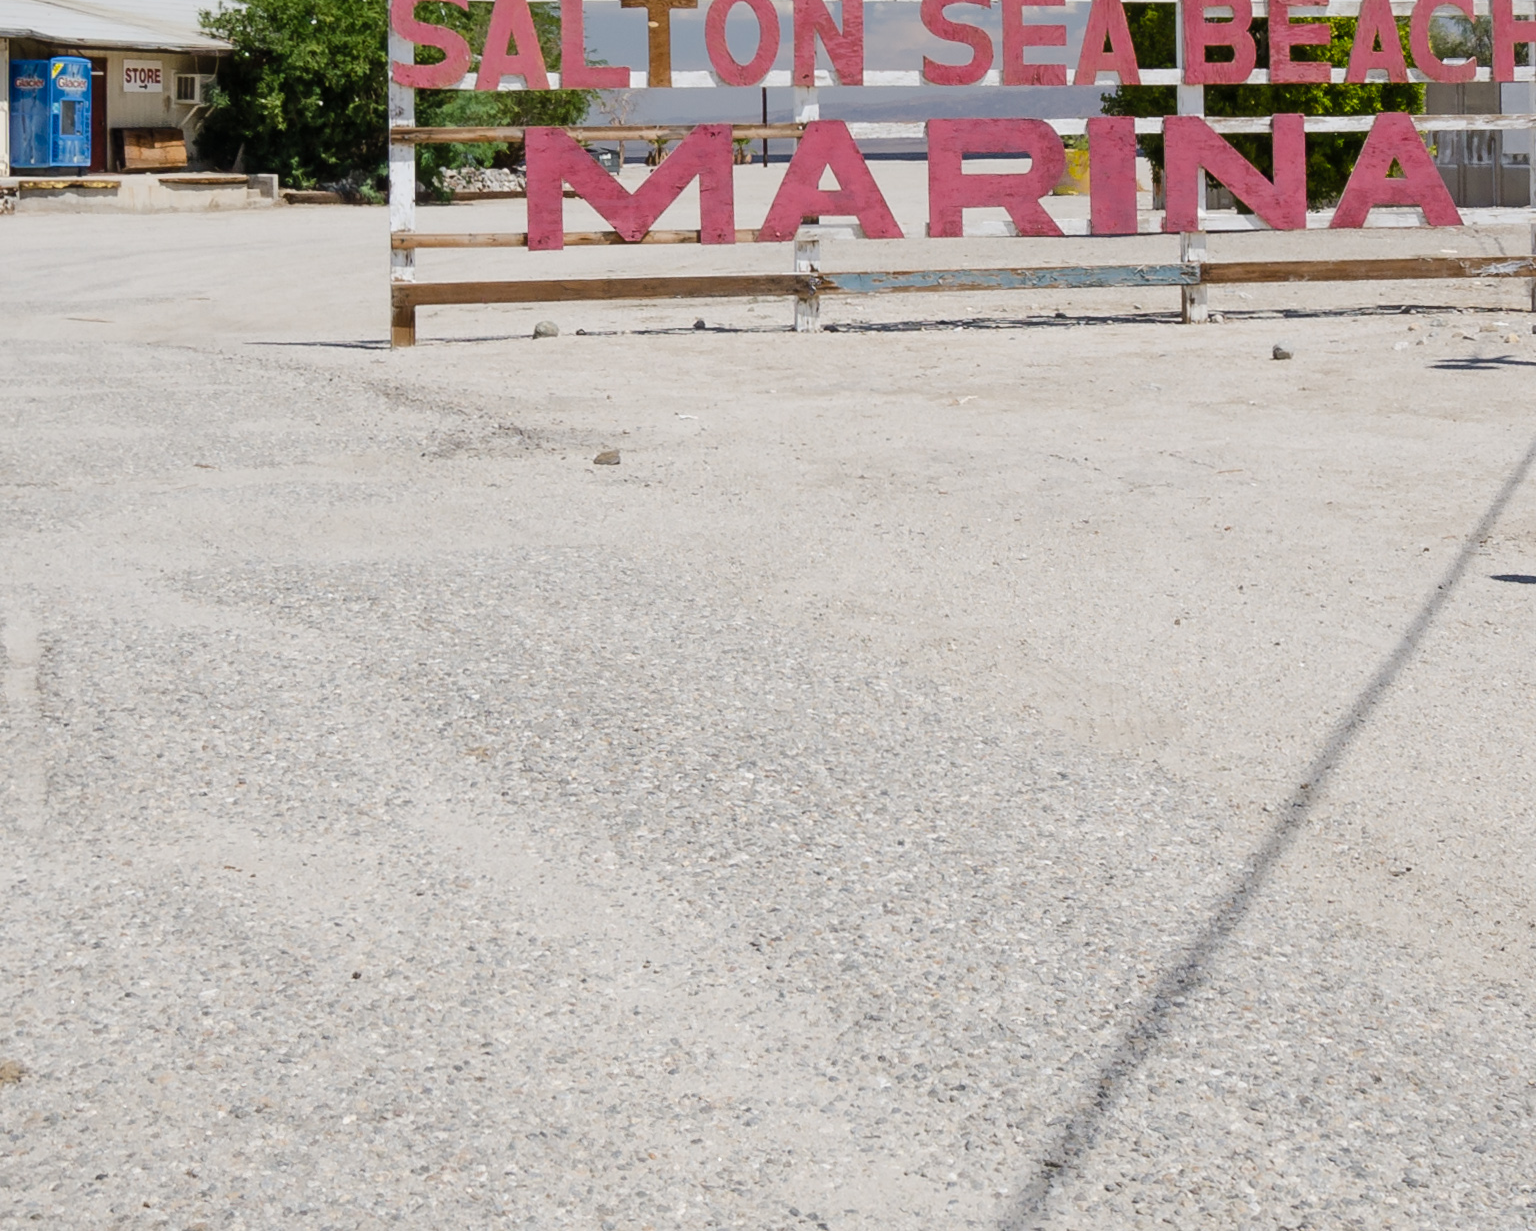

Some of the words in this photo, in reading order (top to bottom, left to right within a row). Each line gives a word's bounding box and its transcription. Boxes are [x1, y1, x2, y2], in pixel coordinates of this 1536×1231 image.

[16, 77, 44, 88] Glacier
[57, 76, 87, 90] Glacier
[125, 67, 161, 84] STORE
[524, 112, 1464, 251] MARINA
